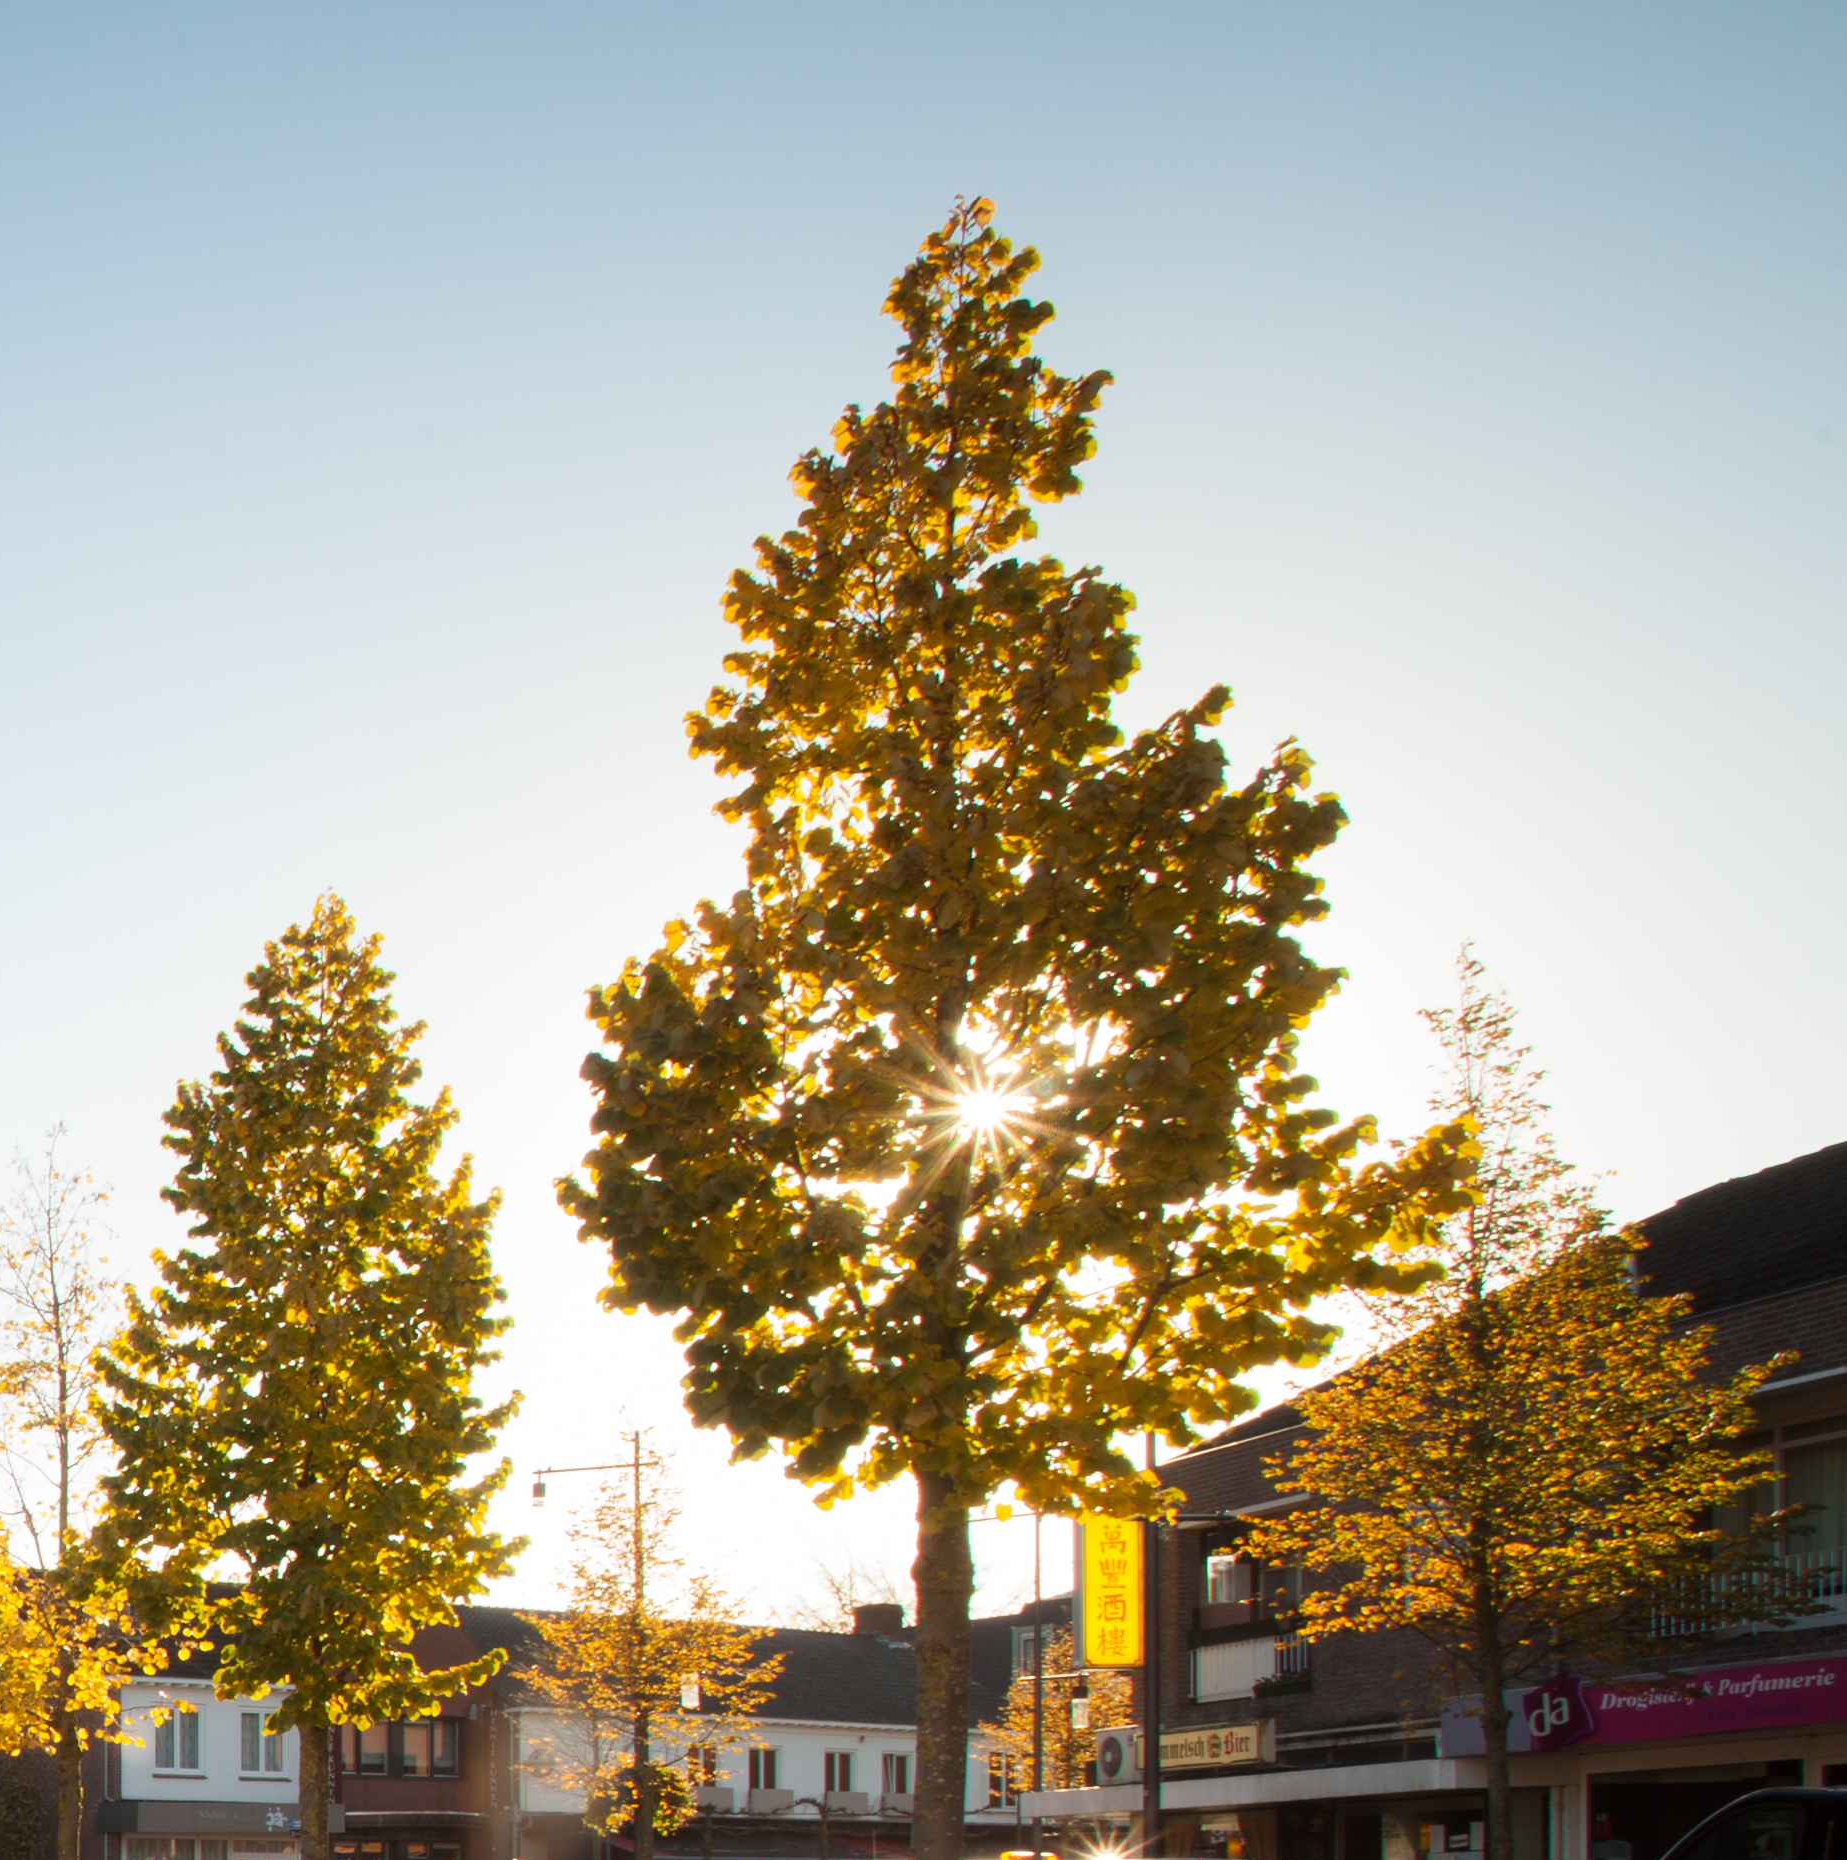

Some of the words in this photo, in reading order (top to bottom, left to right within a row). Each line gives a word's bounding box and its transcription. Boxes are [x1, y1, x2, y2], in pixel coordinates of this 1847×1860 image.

[1096, 1523, 1128, 1657] 萬豐酒樓
[1600, 1682, 1695, 1711] Drogisteij
[1717, 1668, 1836, 1698] Parfumerie
[1528, 1692, 1570, 1737] da
[1159, 1735, 1205, 1760] mmelsch
[1223, 1731, 1251, 1755] Bier
